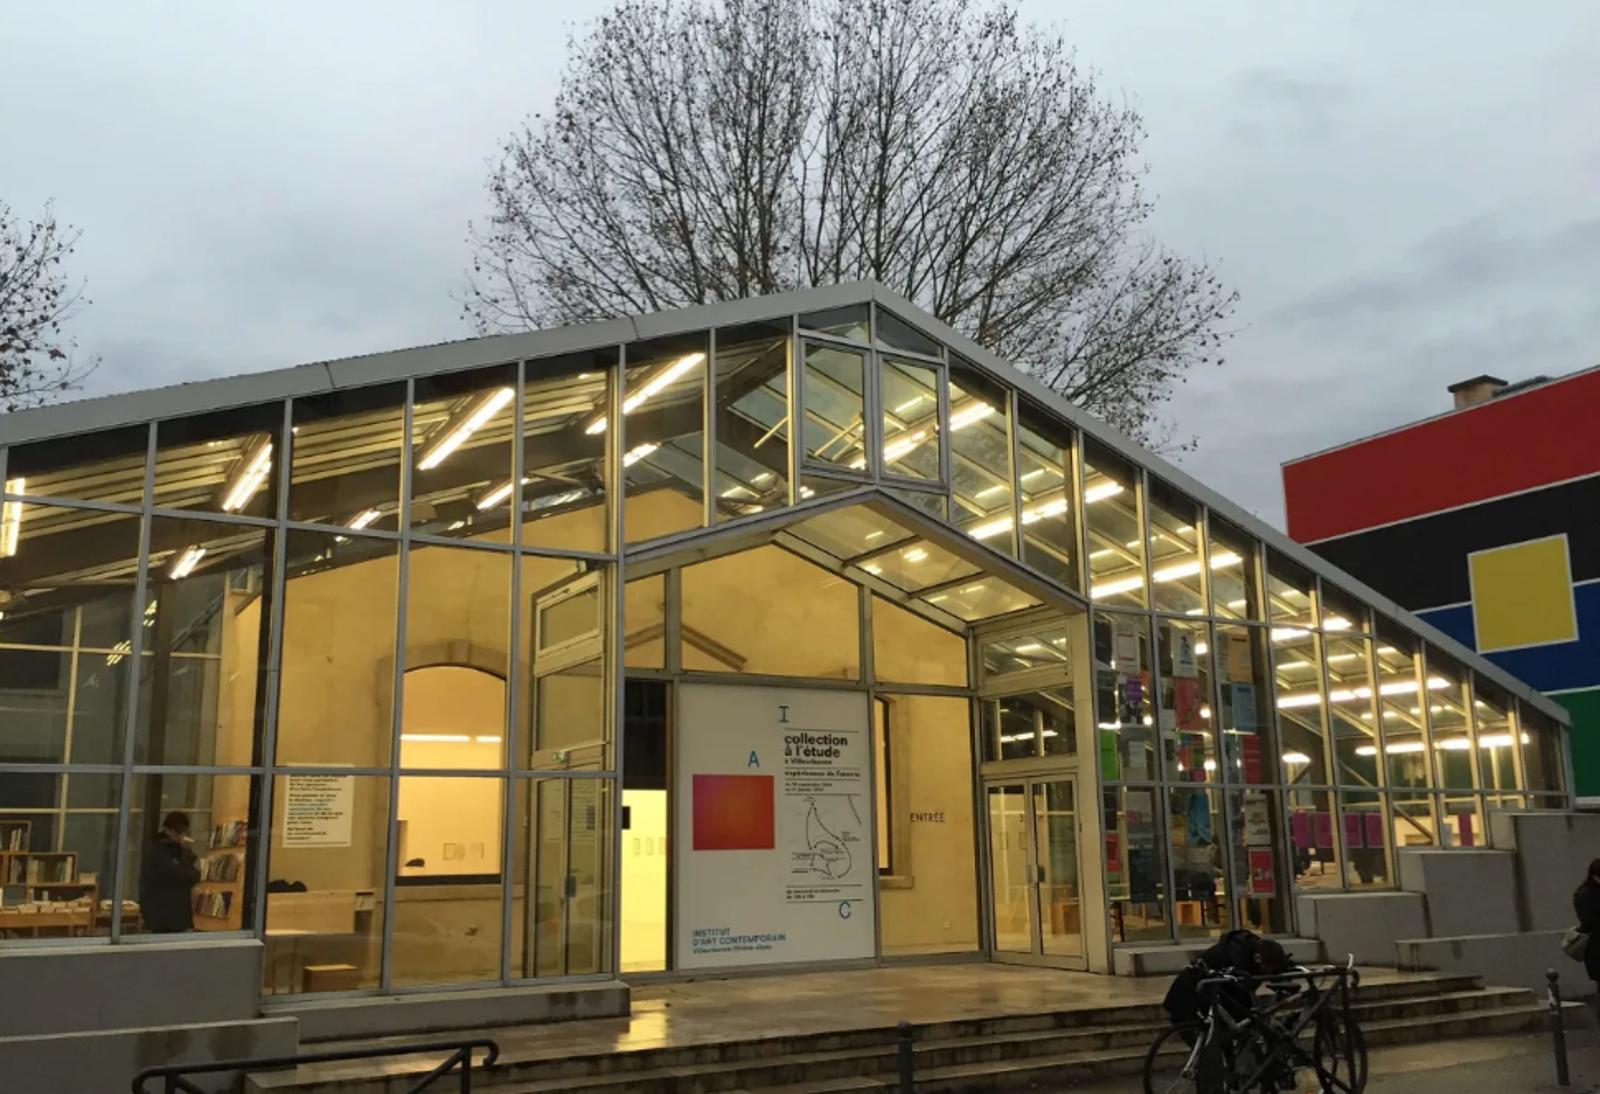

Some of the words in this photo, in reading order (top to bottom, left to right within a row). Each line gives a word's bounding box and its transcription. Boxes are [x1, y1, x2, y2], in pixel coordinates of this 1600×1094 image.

[778, 705, 790, 723] I
[784, 732, 848, 746] collection
[784, 744, 793, 757] à
[795, 744, 841, 758] l'étude
[747, 750, 760, 768] A
[839, 901, 852, 919] C
[692, 928, 730, 938] INSTITUT
[692, 937, 717, 946] D'ART
[719, 933, 786, 945] CONTEMPORAIN
